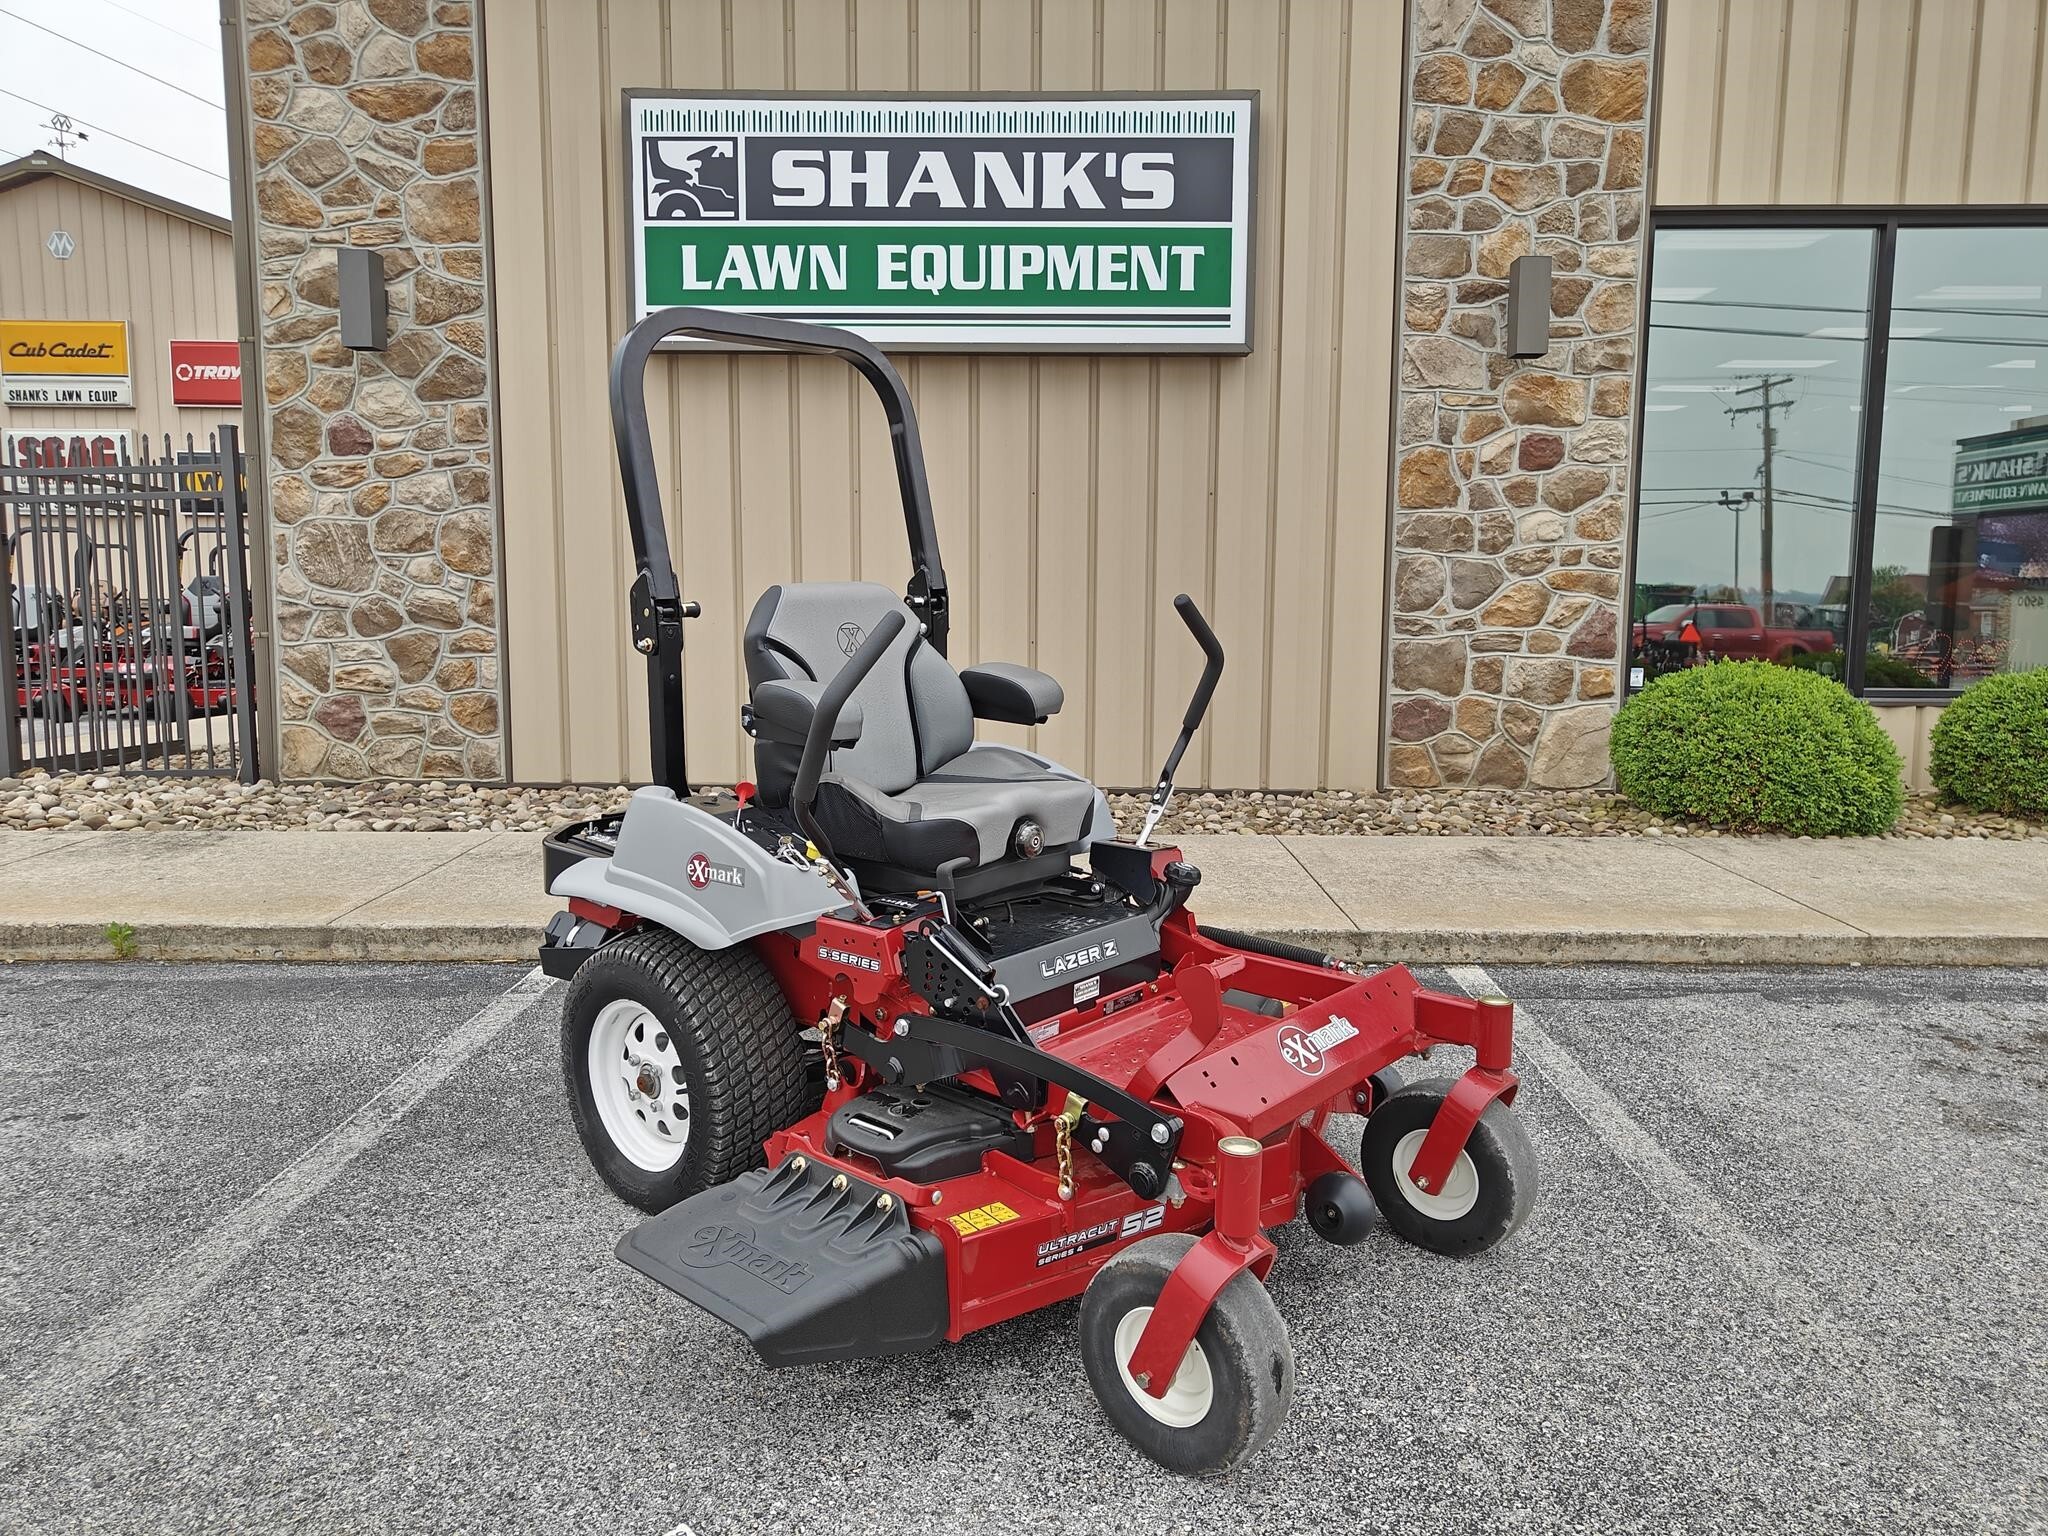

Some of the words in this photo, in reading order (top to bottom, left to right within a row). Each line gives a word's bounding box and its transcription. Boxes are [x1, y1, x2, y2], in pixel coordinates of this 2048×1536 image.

[771, 150, 1175, 210] SHANK'S
[681, 244, 848, 291] LAWN
[876, 244, 1206, 296] EQUIPMENT
[8, 342, 47, 358] Cub
[48, 342, 114, 358] Cadet
[9, 389, 49, 402] SHANK'S
[55, 390, 82, 402] LAWN
[687, 859, 743, 887] eXmark
[1040, 944, 1103, 978] LAZER
[1103, 940, 1119, 959] Z
[1282, 1014, 1359, 1068] eXmark
[1037, 1218, 1119, 1256] ULTRACUT
[1120, 1204, 1165, 1240] 52
[1037, 1249, 1074, 1267] SERIES
[1076, 1245, 1084, 1253] 4
